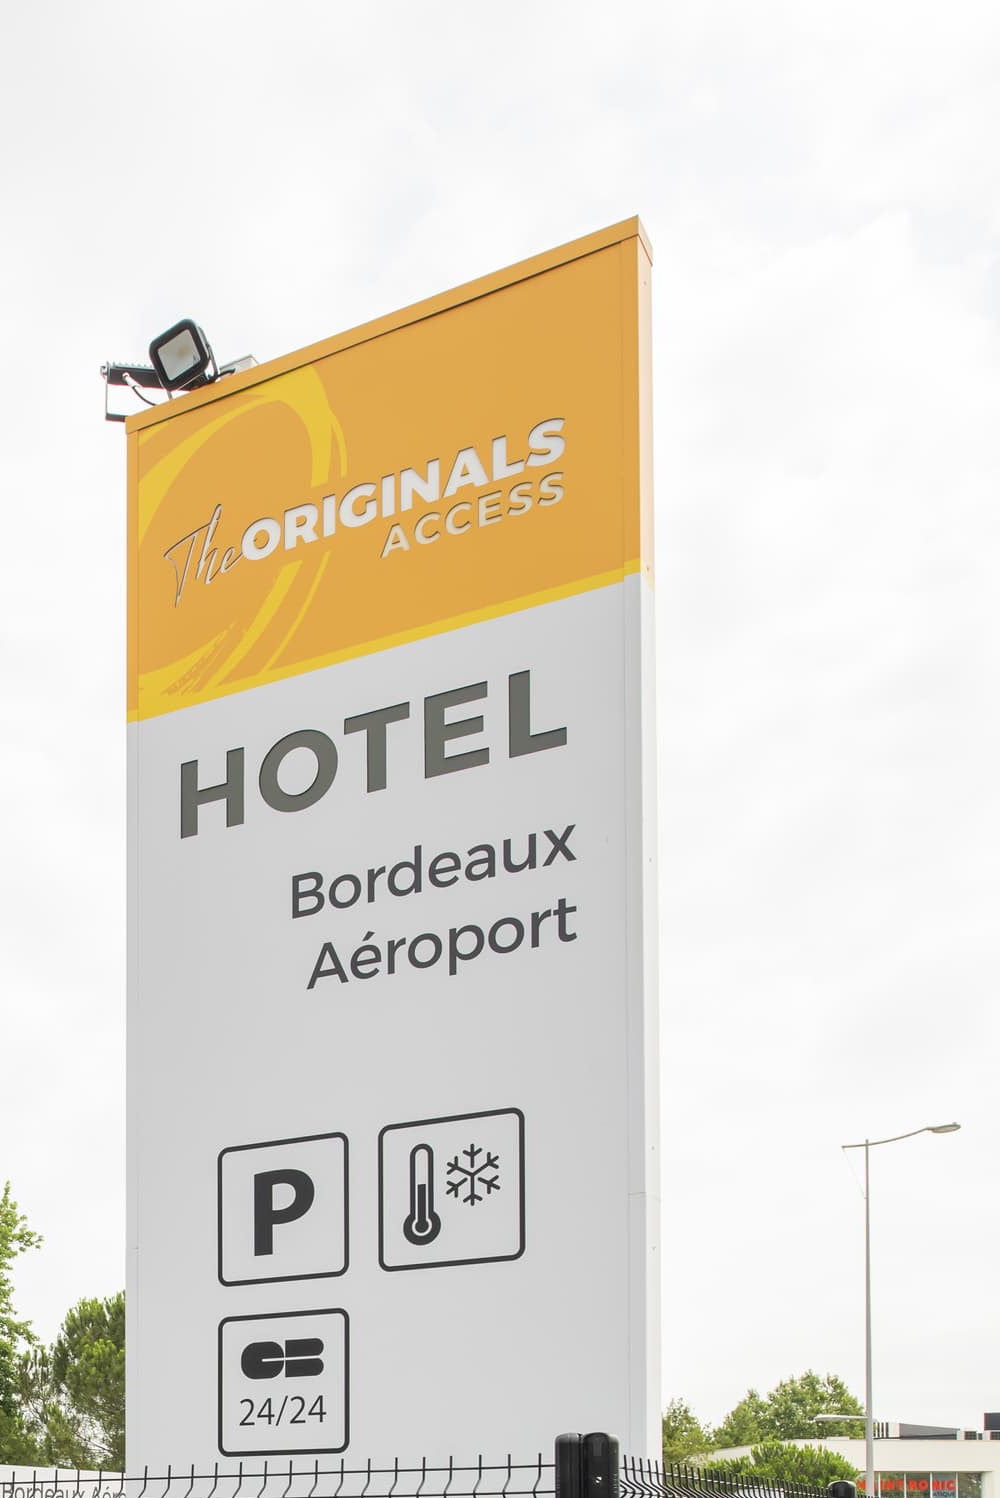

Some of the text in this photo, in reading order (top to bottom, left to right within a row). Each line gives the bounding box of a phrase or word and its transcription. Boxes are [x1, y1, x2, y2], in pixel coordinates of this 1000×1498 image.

[164, 417, 566, 608] The ORIGINALS
[380, 471, 565, 559] ACCESS
[180, 669, 568, 839] HOTEL
[292, 824, 577, 919] Bordeaux
[307, 898, 578, 990] Aéroport
[254, 1168, 315, 1256] P
[239, 1395, 327, 1427] 24/24
